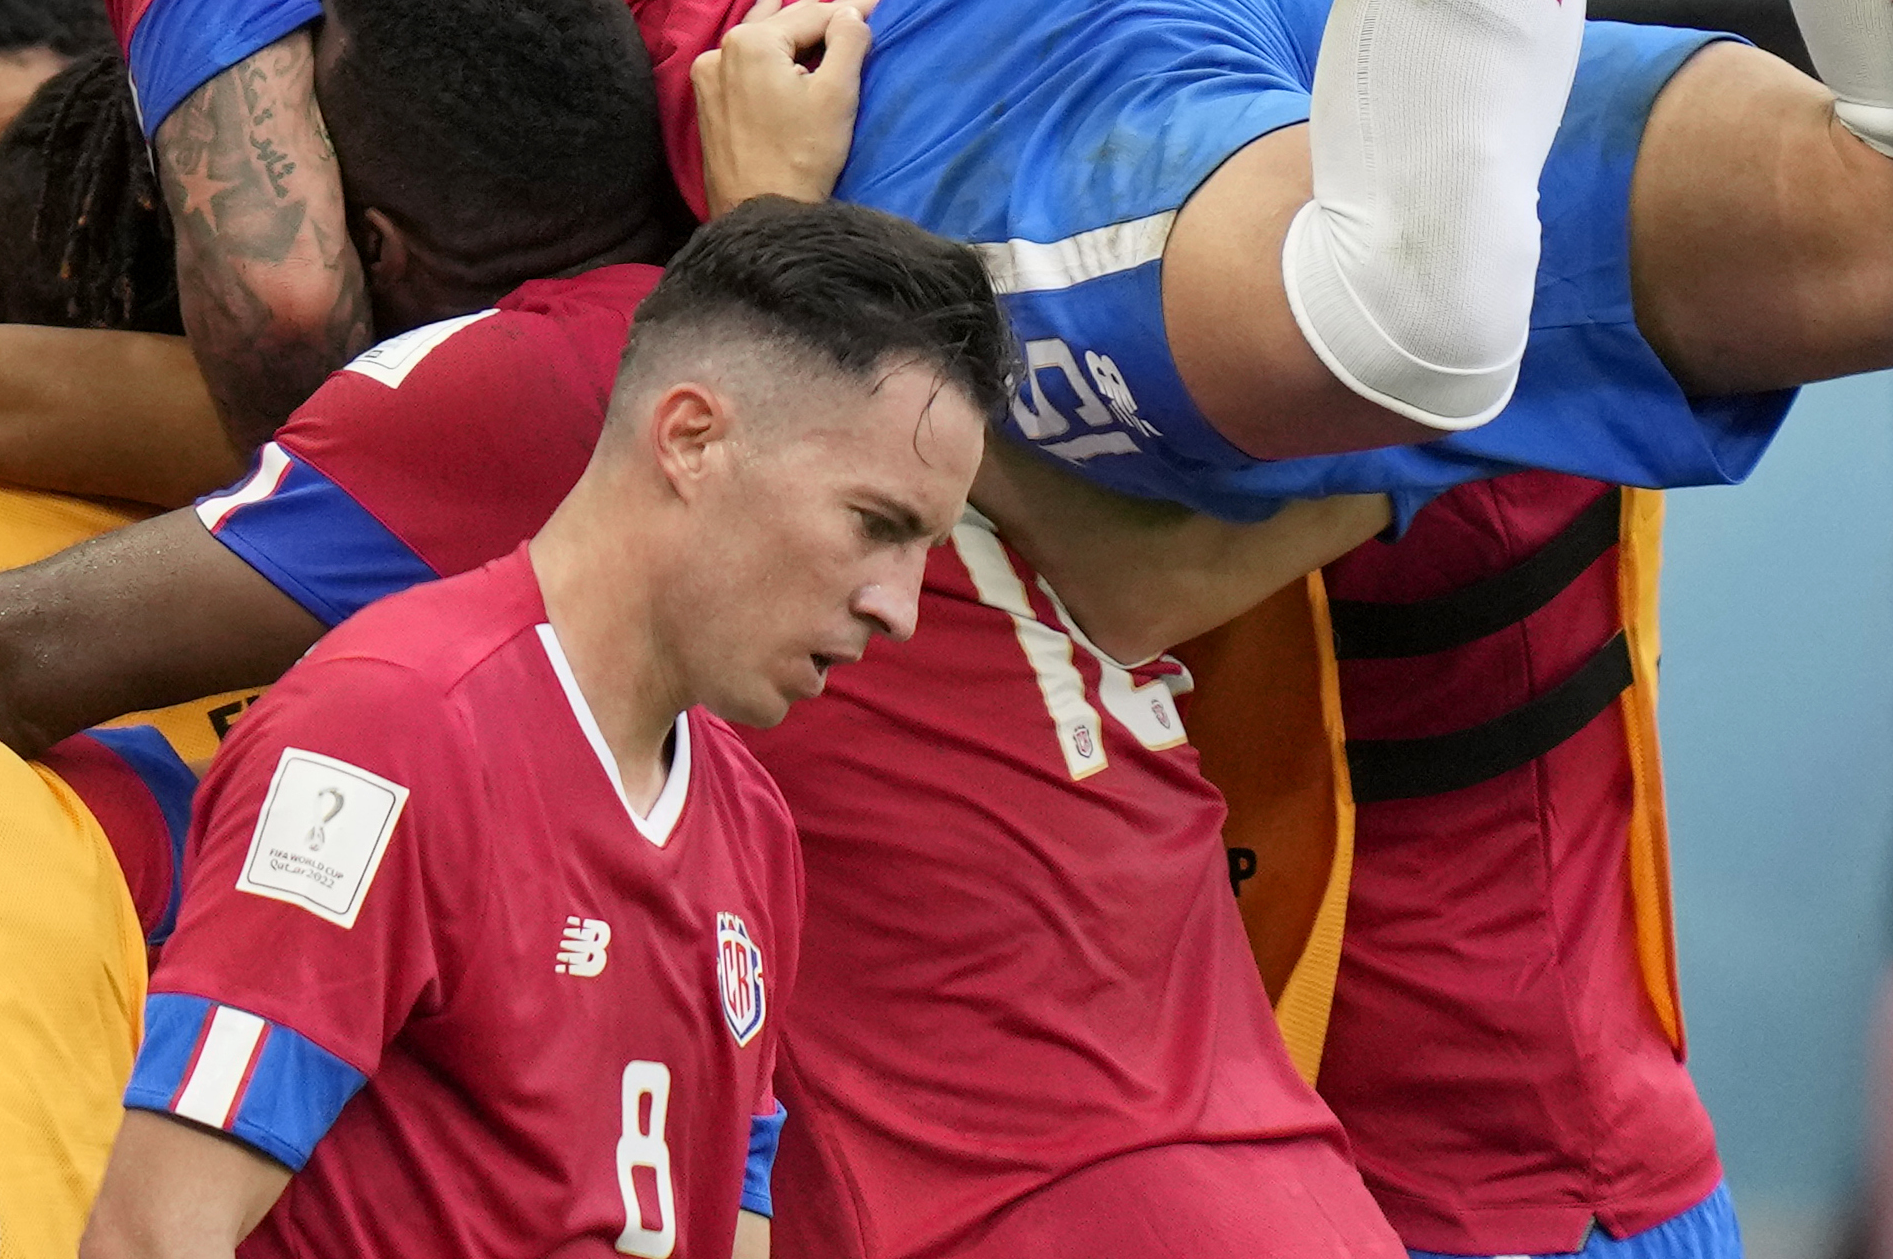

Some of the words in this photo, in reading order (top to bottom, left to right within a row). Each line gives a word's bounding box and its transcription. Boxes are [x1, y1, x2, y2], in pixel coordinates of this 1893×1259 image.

[269, 848, 289, 860] FIFA
[290, 852, 325, 871] WORLD
[325, 867, 344, 879] CUP
[722, 939, 751, 1021] CR
[615, 1060, 677, 1259] 8
